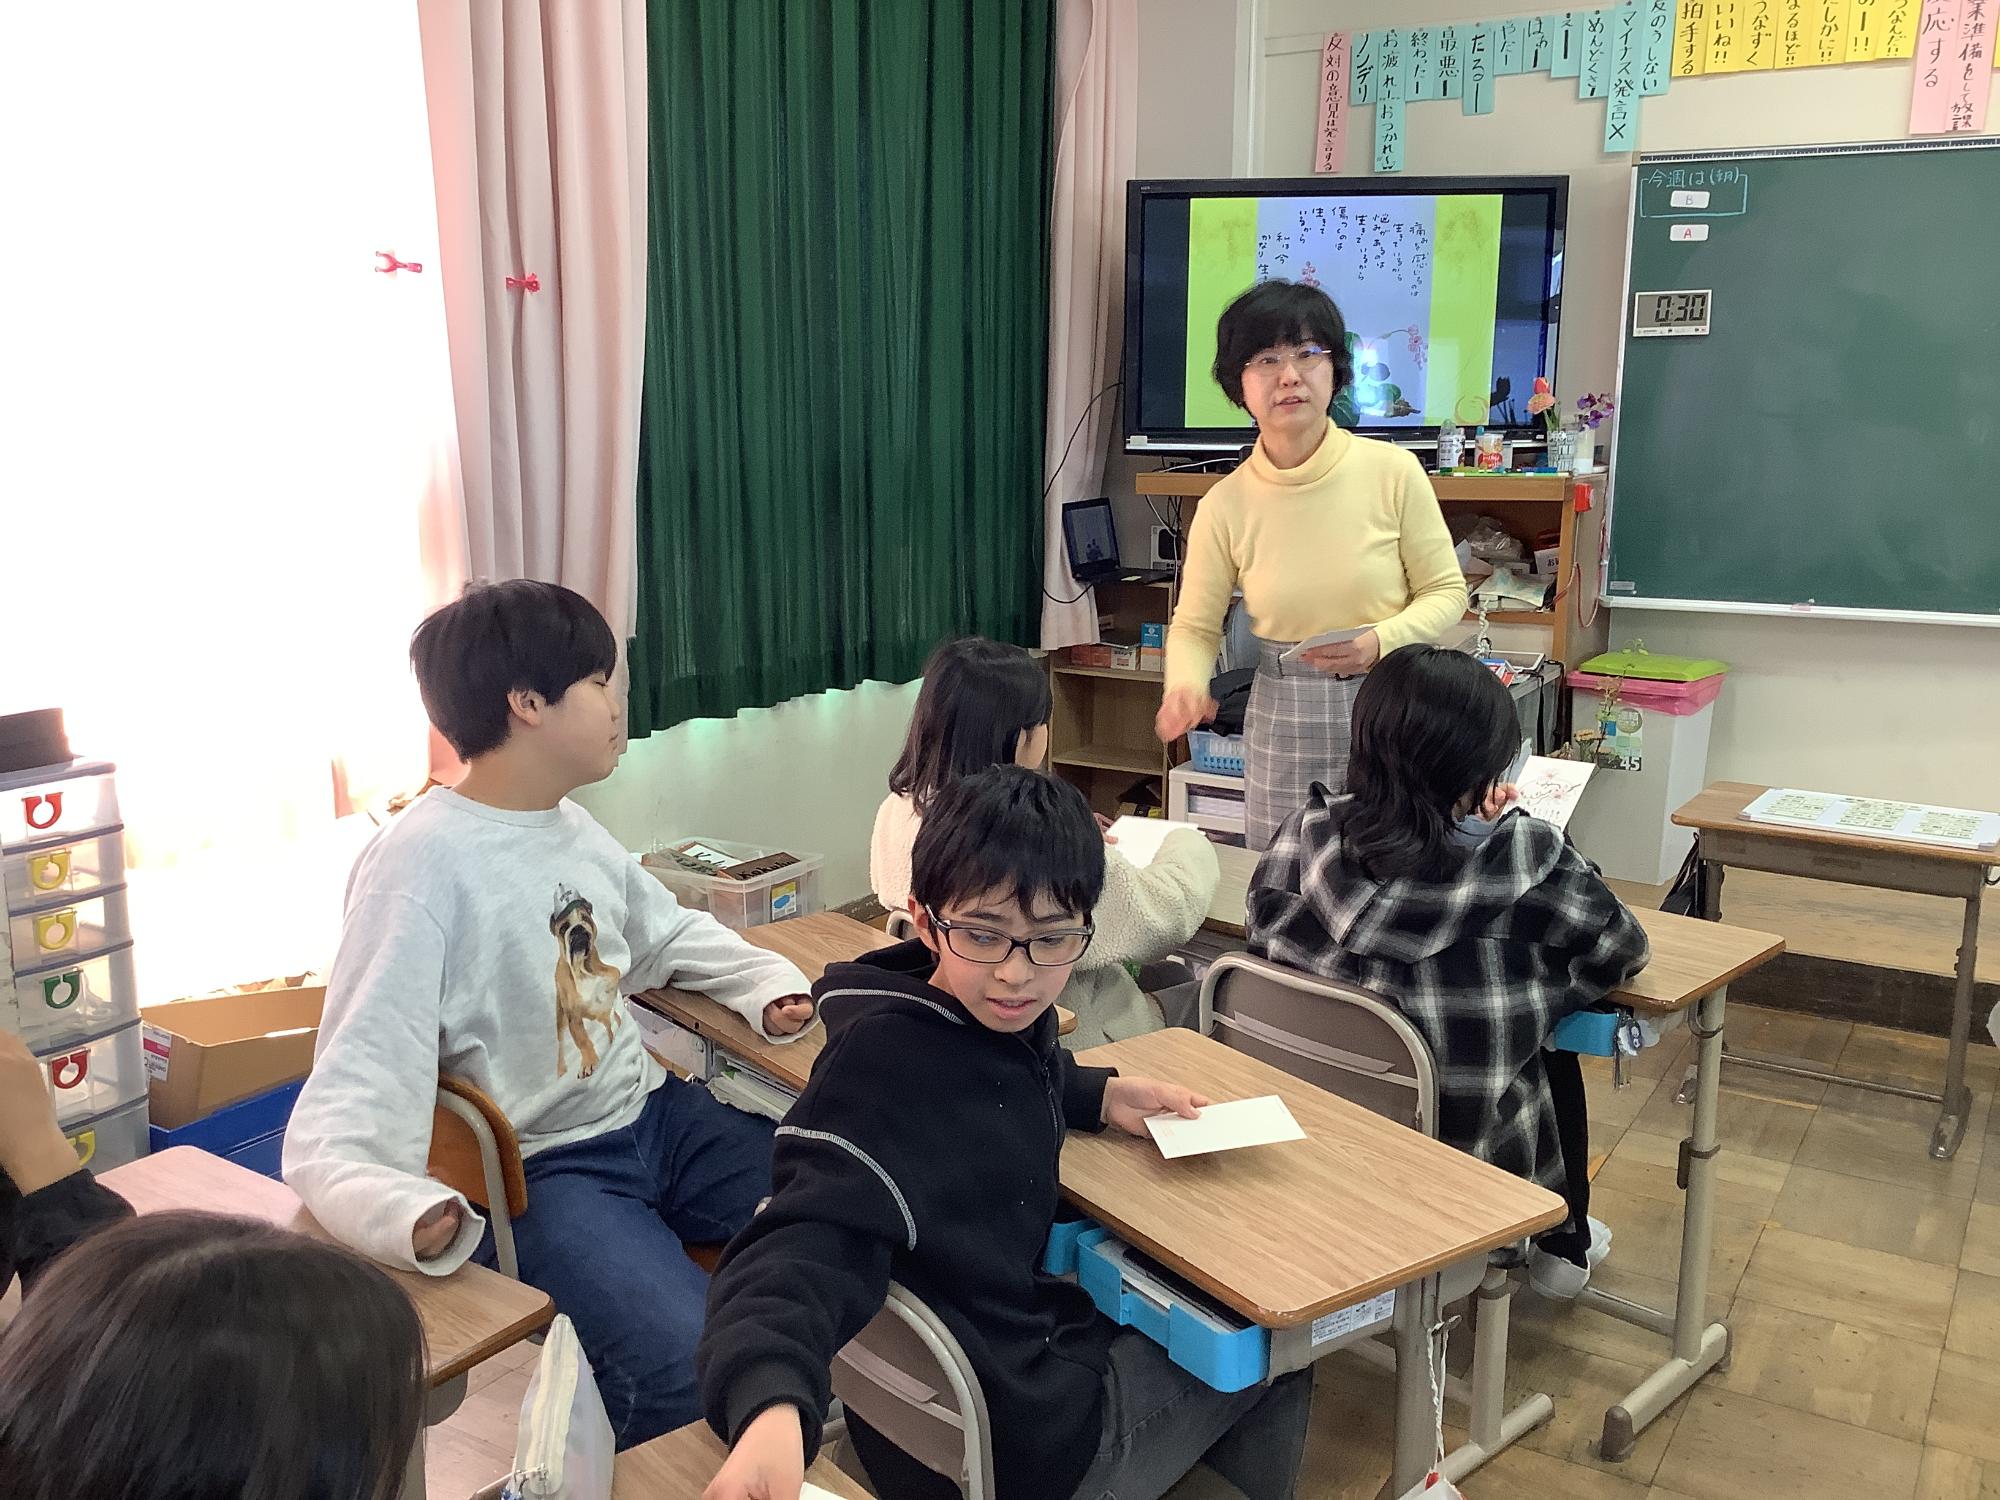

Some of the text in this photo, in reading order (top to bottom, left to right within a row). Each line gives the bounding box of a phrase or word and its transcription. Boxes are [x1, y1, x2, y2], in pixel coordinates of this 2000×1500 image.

[1501, 24, 1516, 66] やだー
[1680, 2, 1704, 74] 拍手する
[1921, 0, 1955, 88] 応する
[1356, 33, 1374, 103] ノンデリ
[1439, 30, 1460, 97] 最悪ー
[1323, 36, 1343, 171] 反対の意見は発言する
[1686, 195, 1694, 205] B
[1258, 234, 1271, 280] かなり生
[1683, 228, 1692, 240] A
[1654, 294, 1707, 323] 0:30
[1620, 756, 1641, 771] 45
